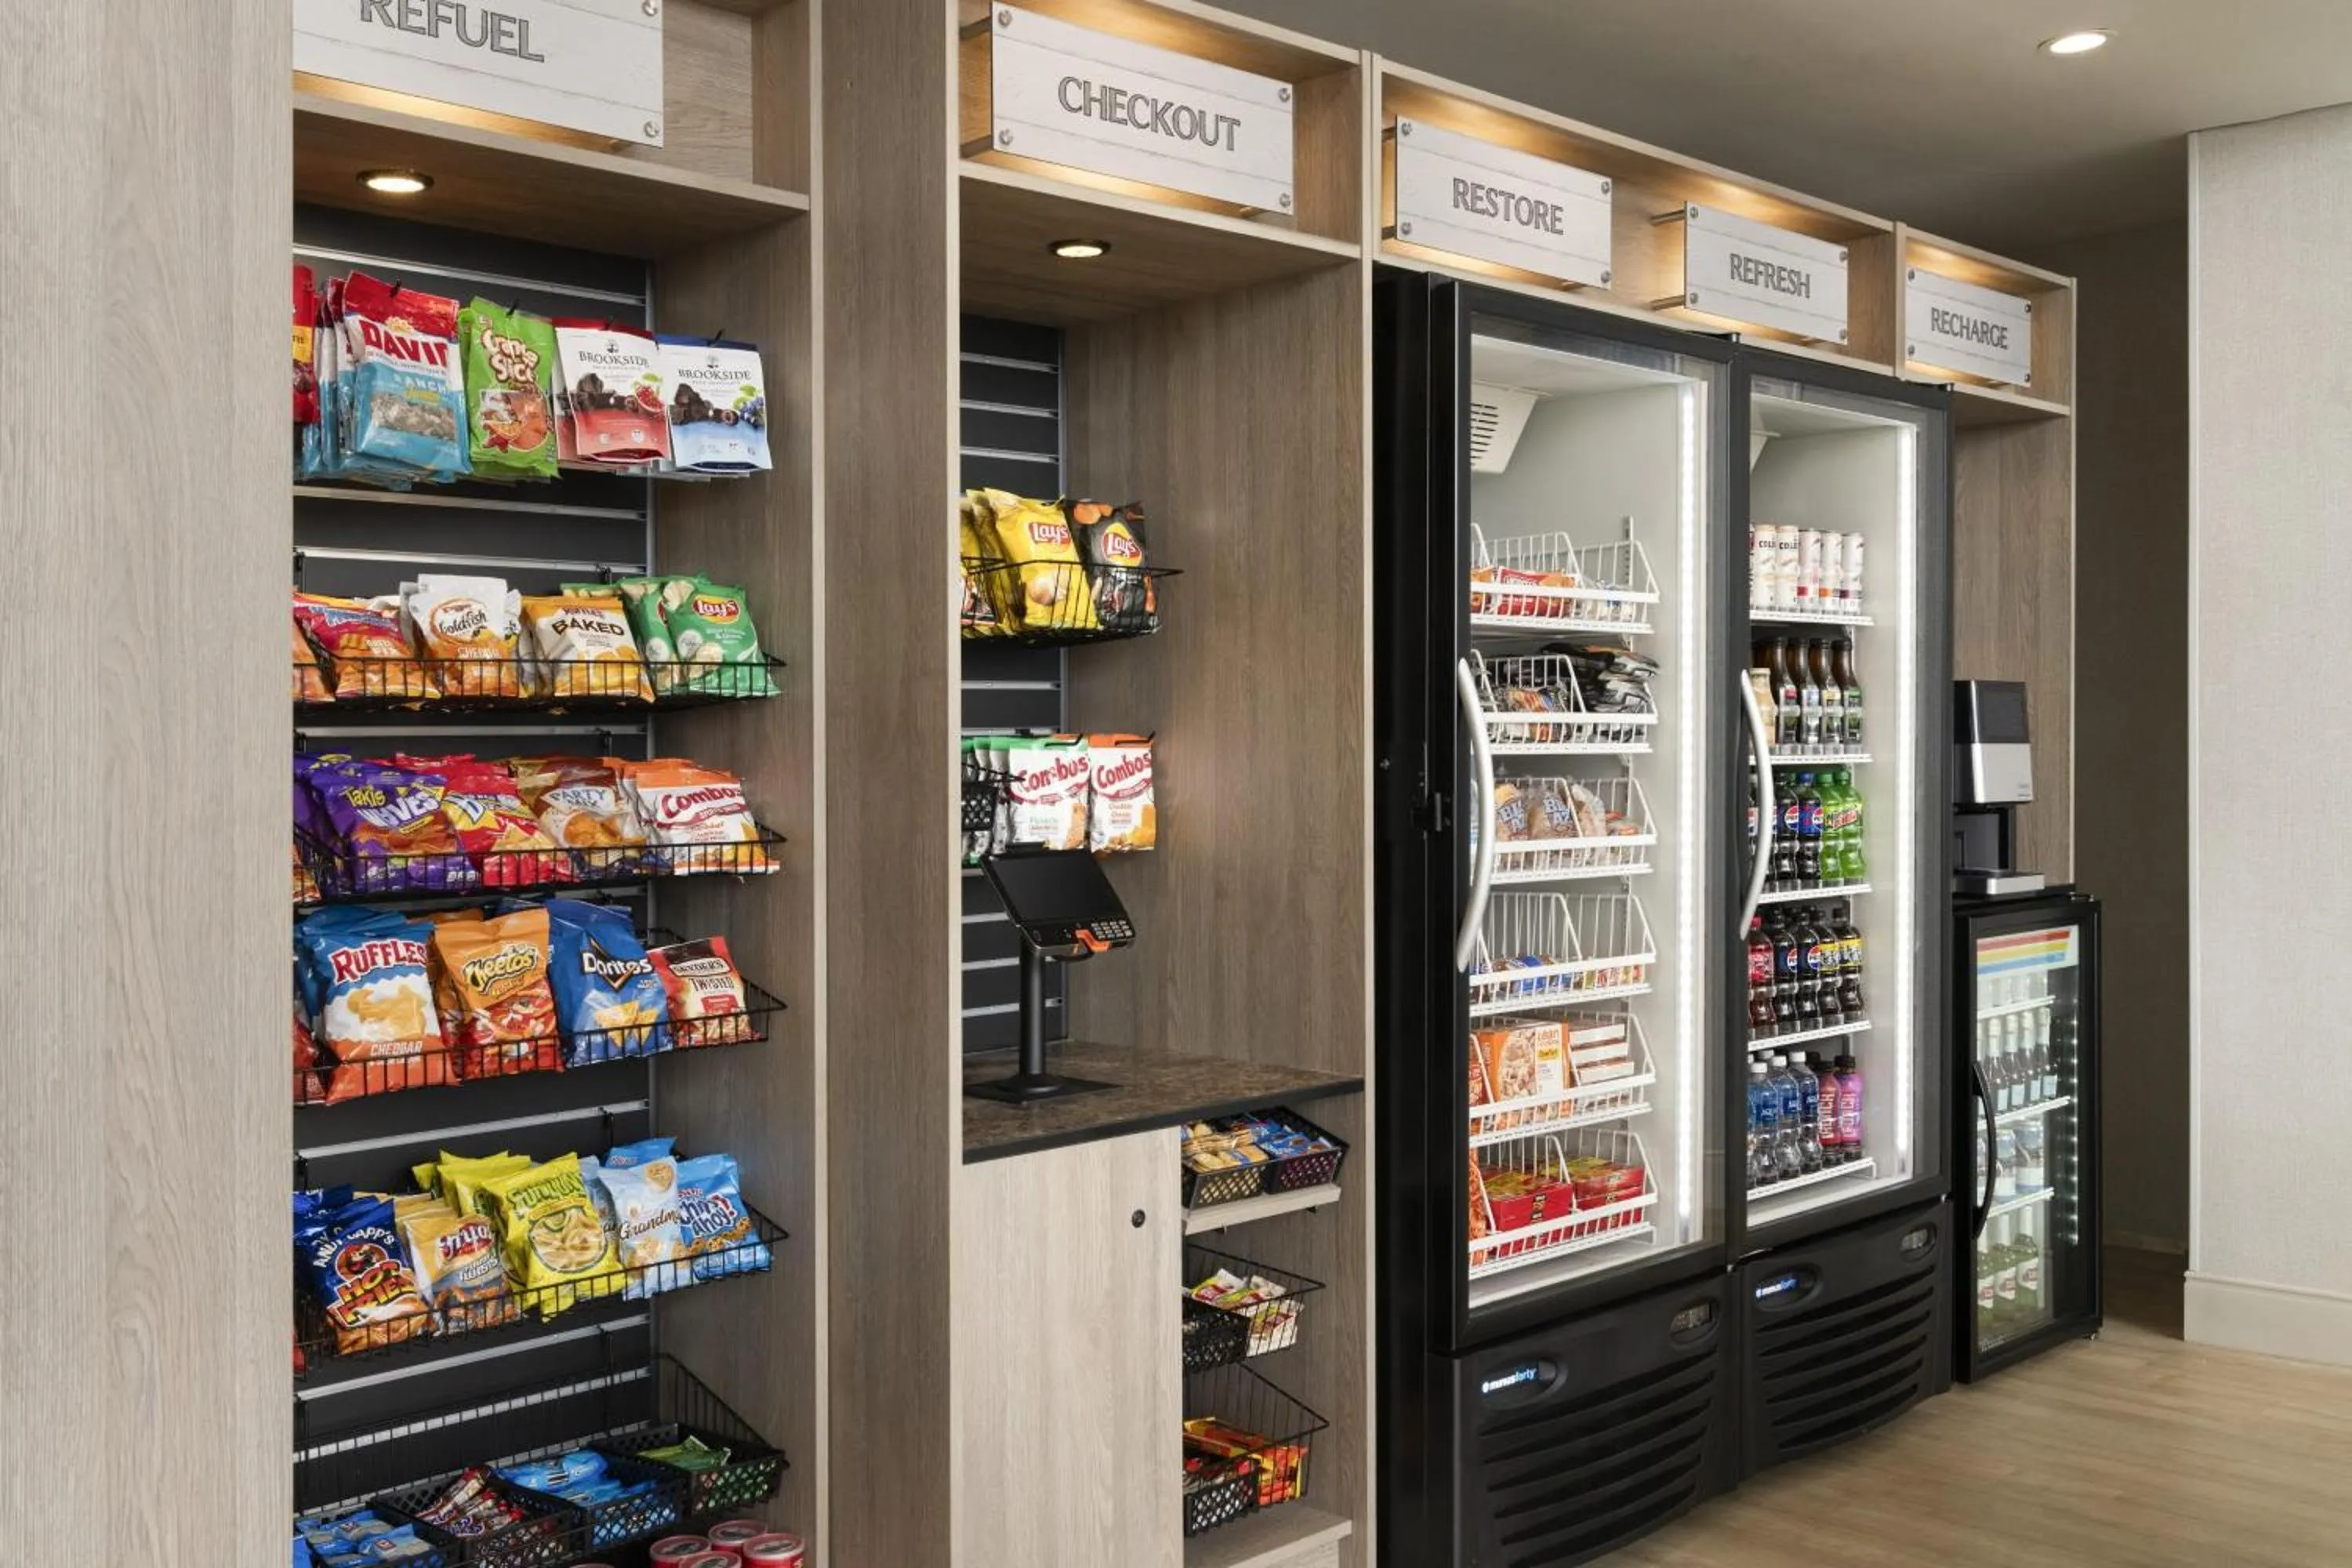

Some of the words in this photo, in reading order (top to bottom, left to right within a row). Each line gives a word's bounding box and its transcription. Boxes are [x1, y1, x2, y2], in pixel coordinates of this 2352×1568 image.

[360, 0, 545, 63] REFUEL
[1058, 76, 1241, 151] CHECKOUT
[1452, 177, 1564, 236] RESTORE
[1730, 252, 1811, 299] REFRESH
[1931, 307, 2009, 350] RECHARGE
[552, 618, 625, 636] BAKED
[583, 952, 653, 975] Doritos
